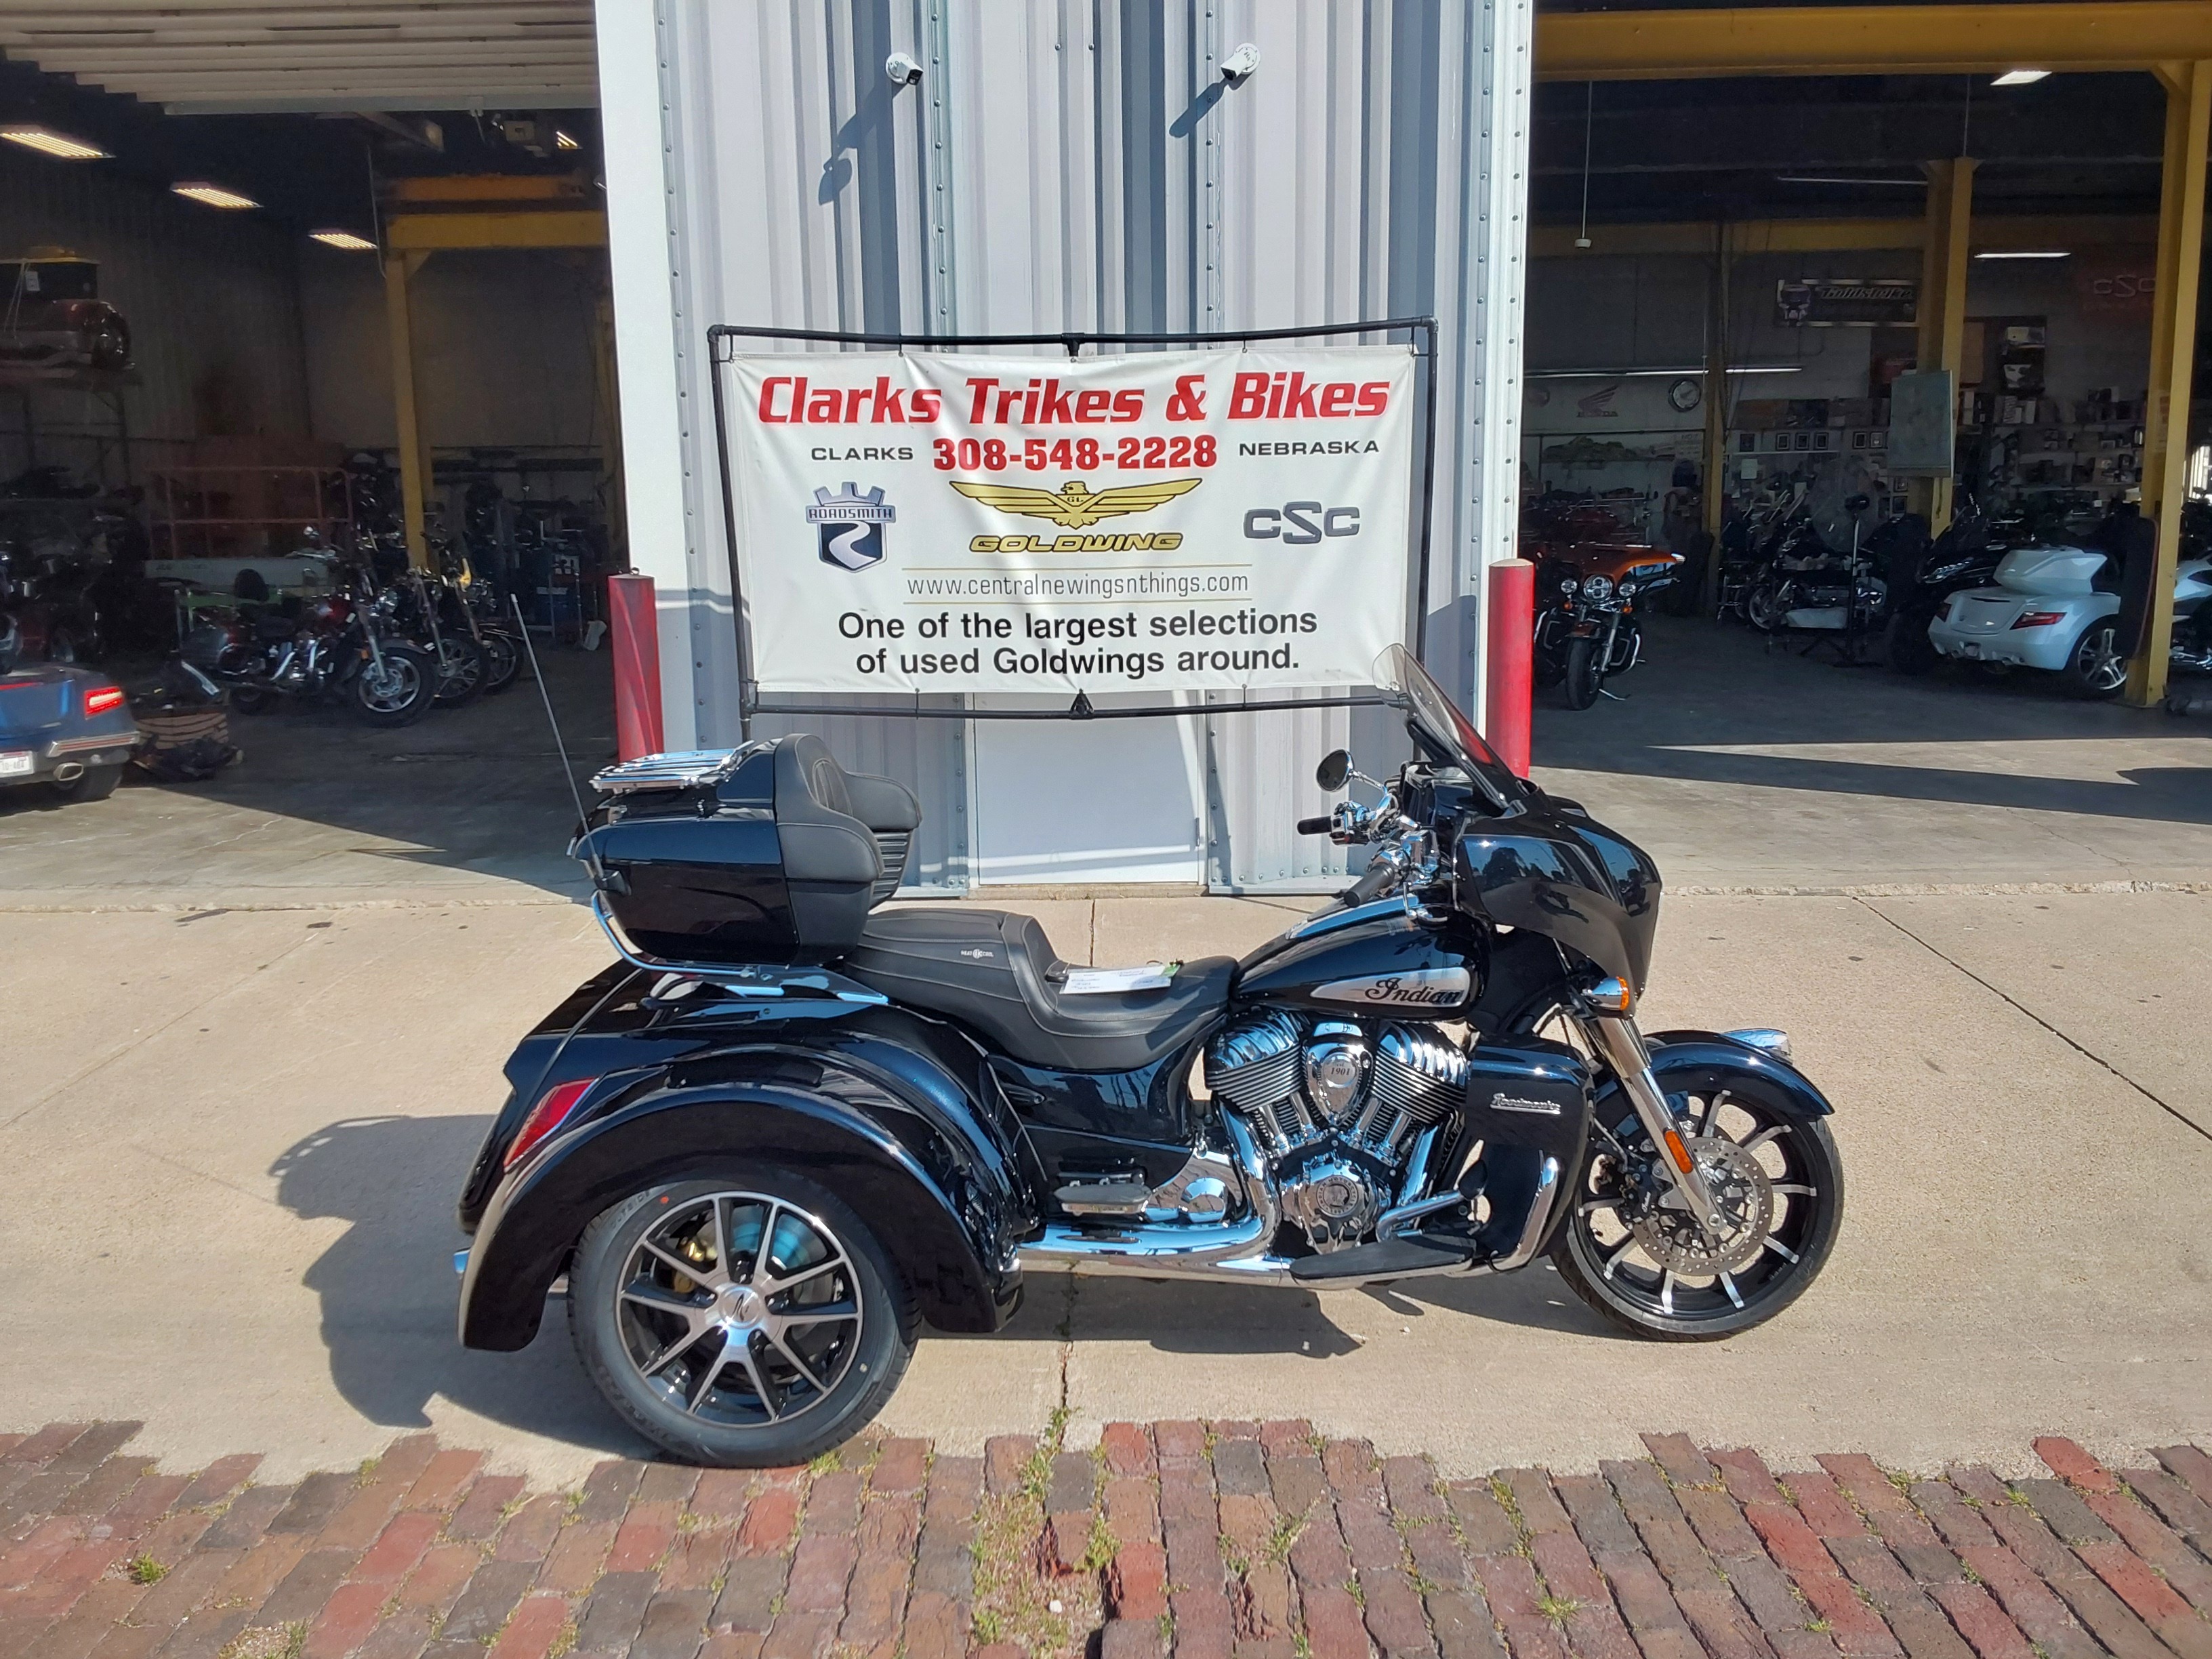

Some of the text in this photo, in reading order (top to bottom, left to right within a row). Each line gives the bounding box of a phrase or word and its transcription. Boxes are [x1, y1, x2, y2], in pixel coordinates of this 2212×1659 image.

[758, 371, 1390, 424] Clarks Trikes & Bikes
[811, 447, 914, 461] CLARKS
[933, 435, 1217, 471] 308-548-2228
[1239, 441, 1379, 456] NEBRASKA
[808, 508, 893, 518] ROADSMITH
[970, 533, 1183, 552] GOLDWING
[907, 571, 1248, 598] www.centralnewingsnthings.com
[838, 607, 1317, 645] One of the largest selections
[856, 642, 1299, 679] of used Goldwings around.
[1365, 977, 1464, 1004] Indian
[1331, 1067, 1351, 1076] 1901
